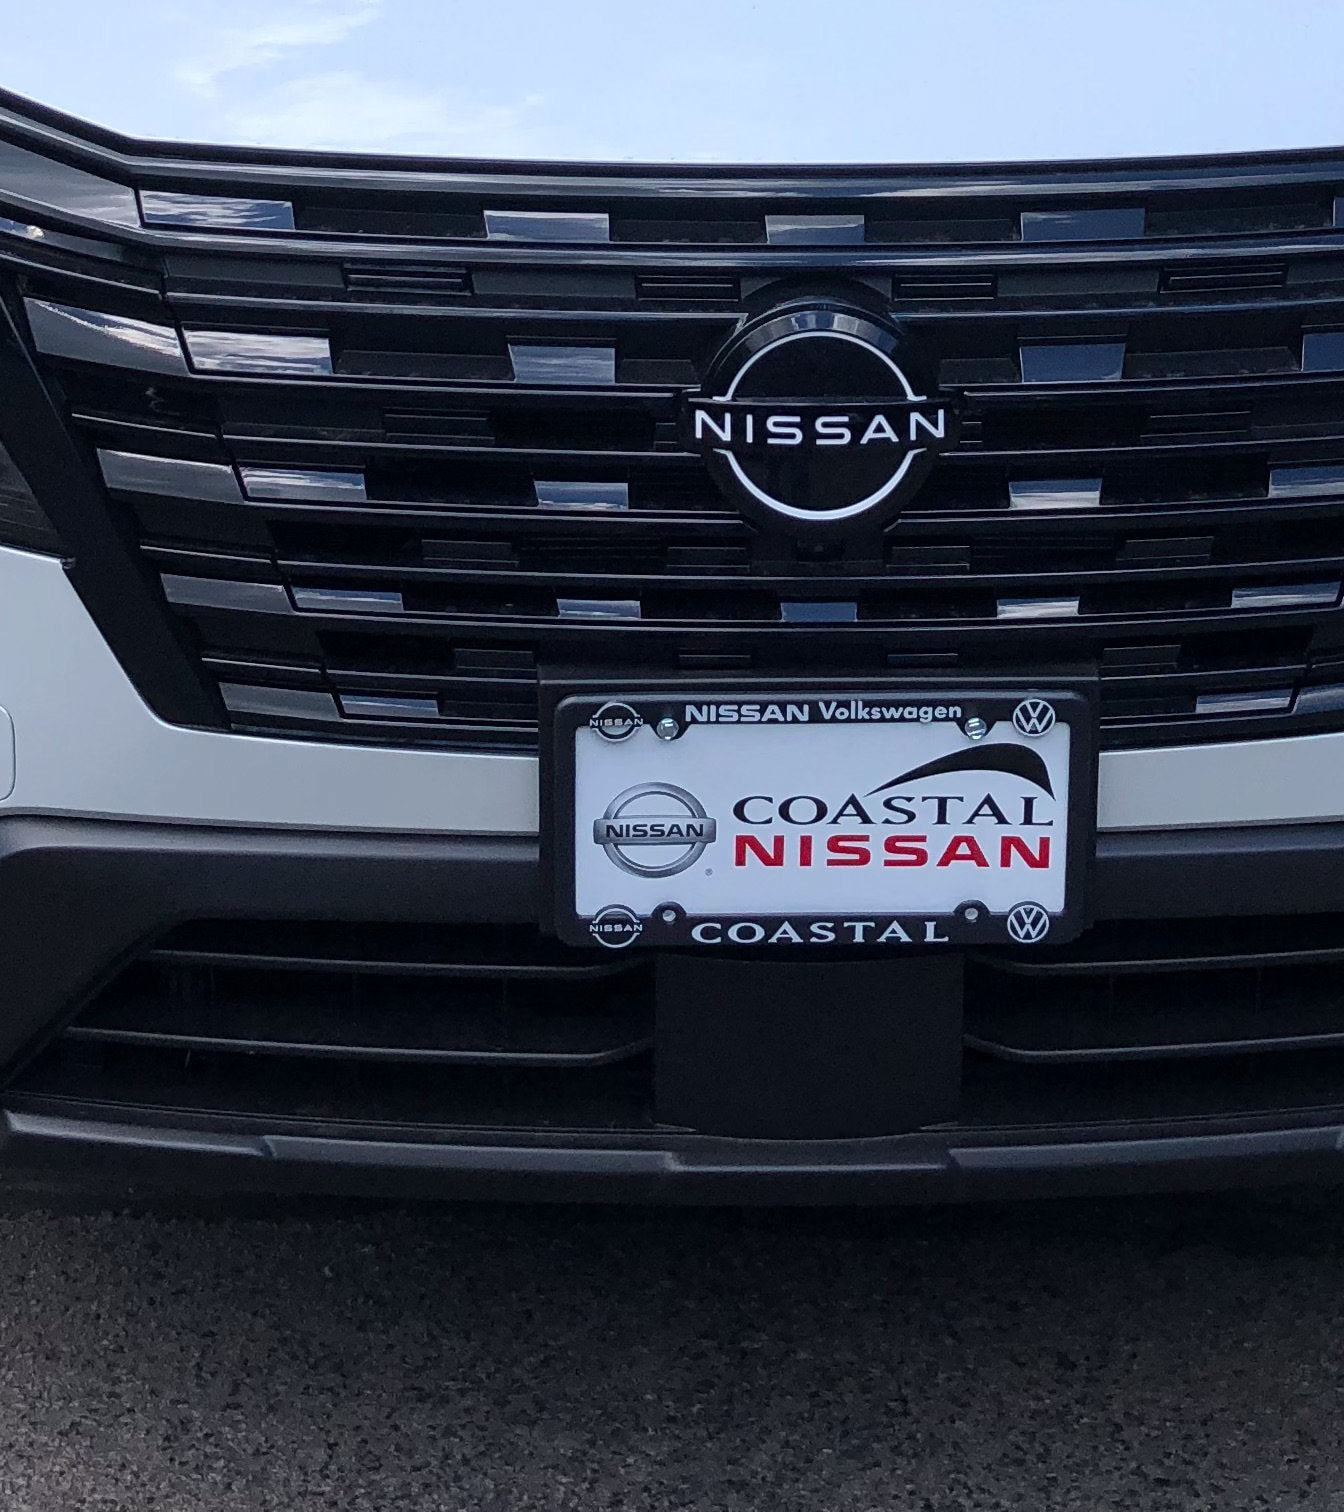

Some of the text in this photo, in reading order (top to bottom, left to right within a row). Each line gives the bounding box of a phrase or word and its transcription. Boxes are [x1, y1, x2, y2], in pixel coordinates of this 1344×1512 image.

[695, 409, 945, 445] NISSAN
[589, 717, 643, 727] NISSAN
[685, 700, 962, 723] NISSAN Volkswagen
[732, 792, 1054, 826] COASTAL
[605, 823, 704, 838] NISSAN
[734, 834, 1051, 869] NISSAN
[589, 924, 643, 932] NISSAN
[691, 921, 949, 943] COASTAL
